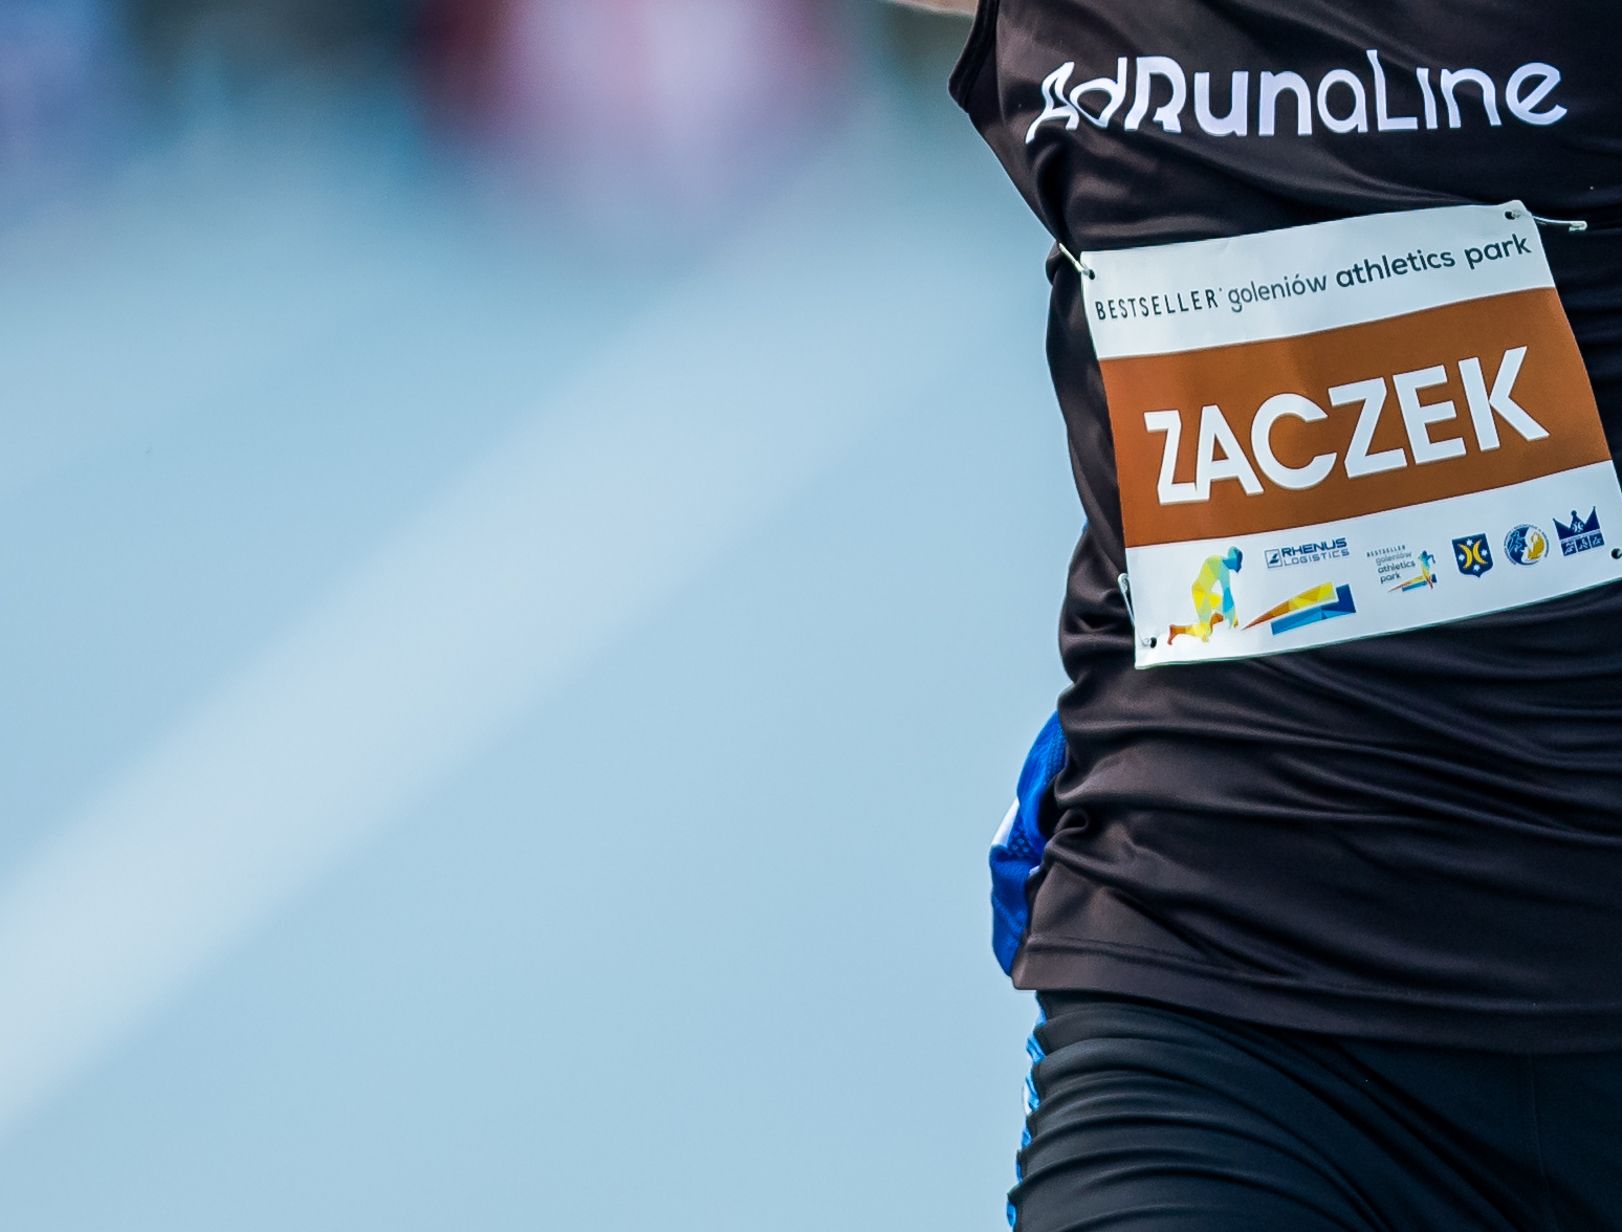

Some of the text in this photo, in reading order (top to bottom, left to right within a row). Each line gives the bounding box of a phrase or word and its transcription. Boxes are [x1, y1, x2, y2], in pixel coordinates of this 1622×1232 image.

[1095, 233, 1532, 320] BESTSELLER goleniów athletics park
[1143, 345, 1551, 506] ZACZEK
[1281, 537, 1347, 557] RHENUS
[1284, 548, 1350, 566] LOGISTICS
[1378, 560, 1416, 573] athletics
[1380, 571, 1401, 584] park
